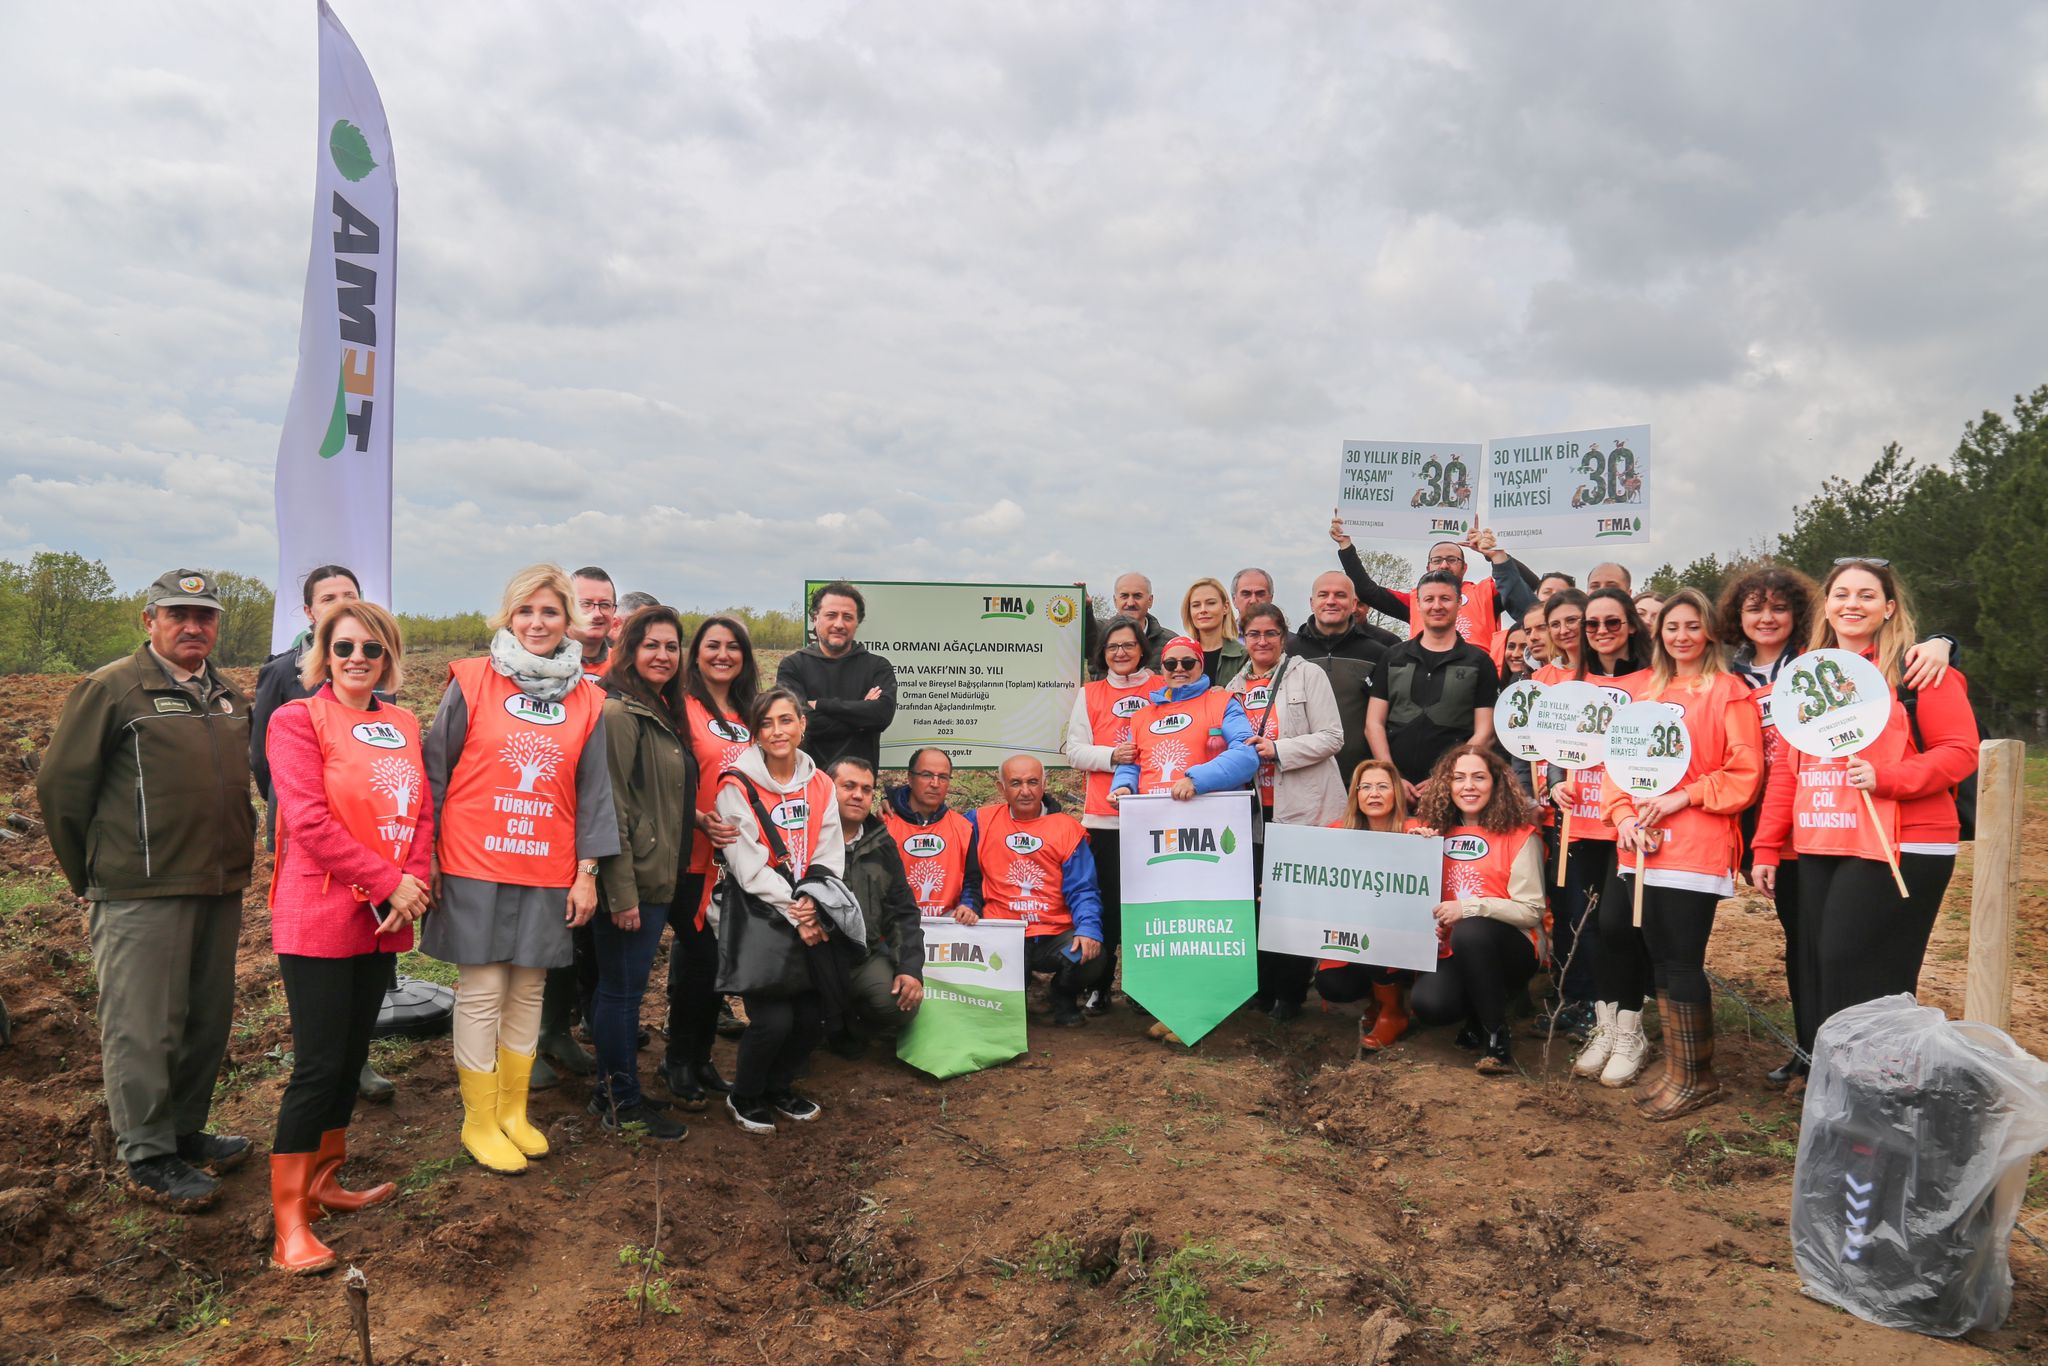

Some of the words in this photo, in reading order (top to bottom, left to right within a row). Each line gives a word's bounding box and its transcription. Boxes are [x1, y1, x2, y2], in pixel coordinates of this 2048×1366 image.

[1346, 450, 1360, 463] 30
[1364, 451, 1398, 464] YILLIK
[1401, 450, 1421, 465] BİR
[1494, 450, 1509, 465] 30
[1514, 445, 1552, 463] YILLIK
[1556, 441, 1579, 459] BİR
[1345, 469, 1393, 485] "YAŞAM"
[1420, 461, 1467, 507] 30
[1494, 468, 1548, 489] "YAŞAM"
[1581, 448, 1635, 505] 30
[1343, 485, 1394, 501] HİKAYESİ
[1494, 487, 1551, 508] HİKAYESİ
[1431, 519, 1459, 531] TEMA
[1597, 518, 1631, 531] TEMA
[983, 596, 1023, 613] TEMA
[893, 641, 940, 651] ORMANI
[944, 640, 1043, 654] AĞAÇLANDIRMASI
[892, 665, 915, 674] EMA
[969, 666, 984, 675] 30.
[987, 666, 1004, 675] YILI
[929, 680, 957, 688] Bireysel
[1005, 680, 1036, 689] (Toplam)
[1037, 681, 1075, 690] Katkılarıyla
[1791, 660, 1849, 718] 30
[902, 691, 927, 699] Orman
[928, 691, 949, 699] Genel
[951, 691, 990, 700] Müdürlüğü
[519, 697, 550, 715] TEMA
[1119, 702, 1140, 712] TEMA
[1540, 700, 1548, 709] 30
[1550, 701, 1570, 711] YILLIK
[1620, 725, 1640, 734] YILLIK
[1828, 730, 1857, 747] TEMA
[1559, 749, 1580, 760] TEMA
[1632, 777, 1651, 787] TEMA
[493, 794, 555, 817] TÜRKİYE
[1812, 787, 1837, 811] ÇÖL
[507, 816, 534, 837] ÇÖL
[1799, 811, 1857, 829] OLMASIN
[484, 835, 550, 856] OLMASIN
[913, 838, 935, 848] TEMA
[1149, 828, 1217, 853] TEMA
[1451, 839, 1476, 851] TEMA
[1271, 861, 1430, 898] #TEMA30YAŞINDA
[1145, 917, 1234, 936] LÜLEBURGAZ
[1323, 930, 1359, 947] TEMA
[926, 942, 985, 963] TEMA
[1134, 940, 1165, 958] YENİ
[1170, 938, 1246, 957] MAHALLESİ
[923, 987, 1003, 1011] ÜLEBURGAZ
